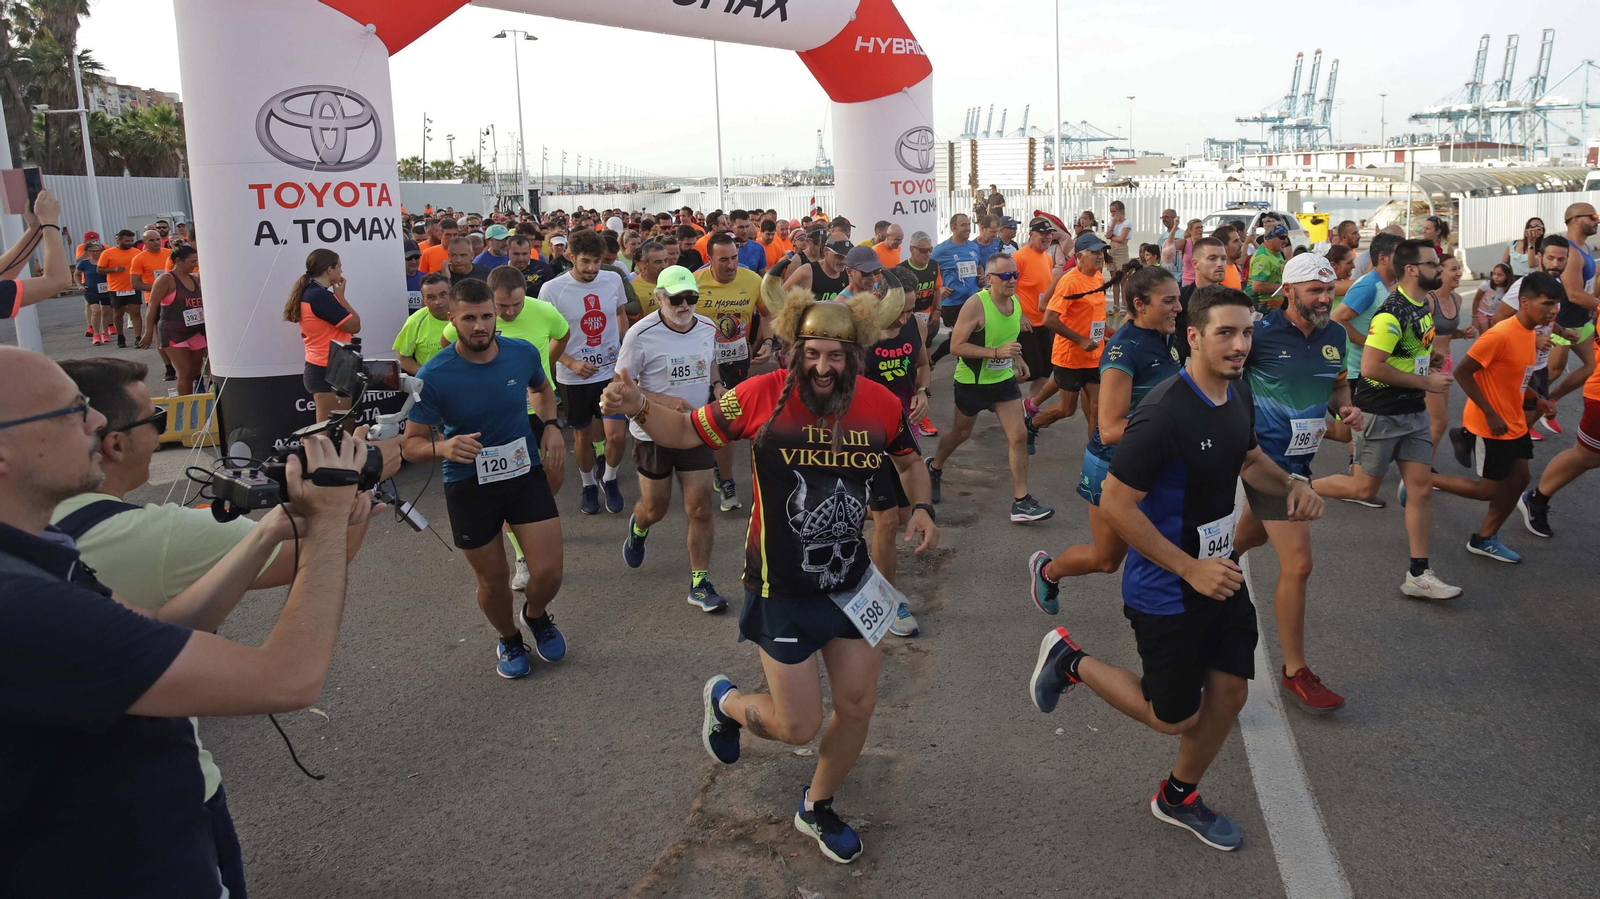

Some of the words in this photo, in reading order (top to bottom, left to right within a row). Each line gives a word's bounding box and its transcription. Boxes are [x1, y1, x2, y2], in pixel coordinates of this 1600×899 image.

[248, 181, 393, 210] TOYOTA
[892, 201, 909, 215] A.
[910, 197, 937, 214] TOM
[254, 220, 288, 246] A.
[292, 216, 397, 244] TOMAX
[408, 296, 421, 304] 615
[186, 314, 198, 322] 392
[720, 348, 737, 358] 924
[671, 365, 691, 378] 485
[879, 359, 901, 370] QUE
[880, 368, 906, 382] TU
[1294, 432, 1311, 446] 196
[482, 457, 508, 473] 120
[1208, 533, 1229, 557] 944
[860, 600, 884, 631] 598
